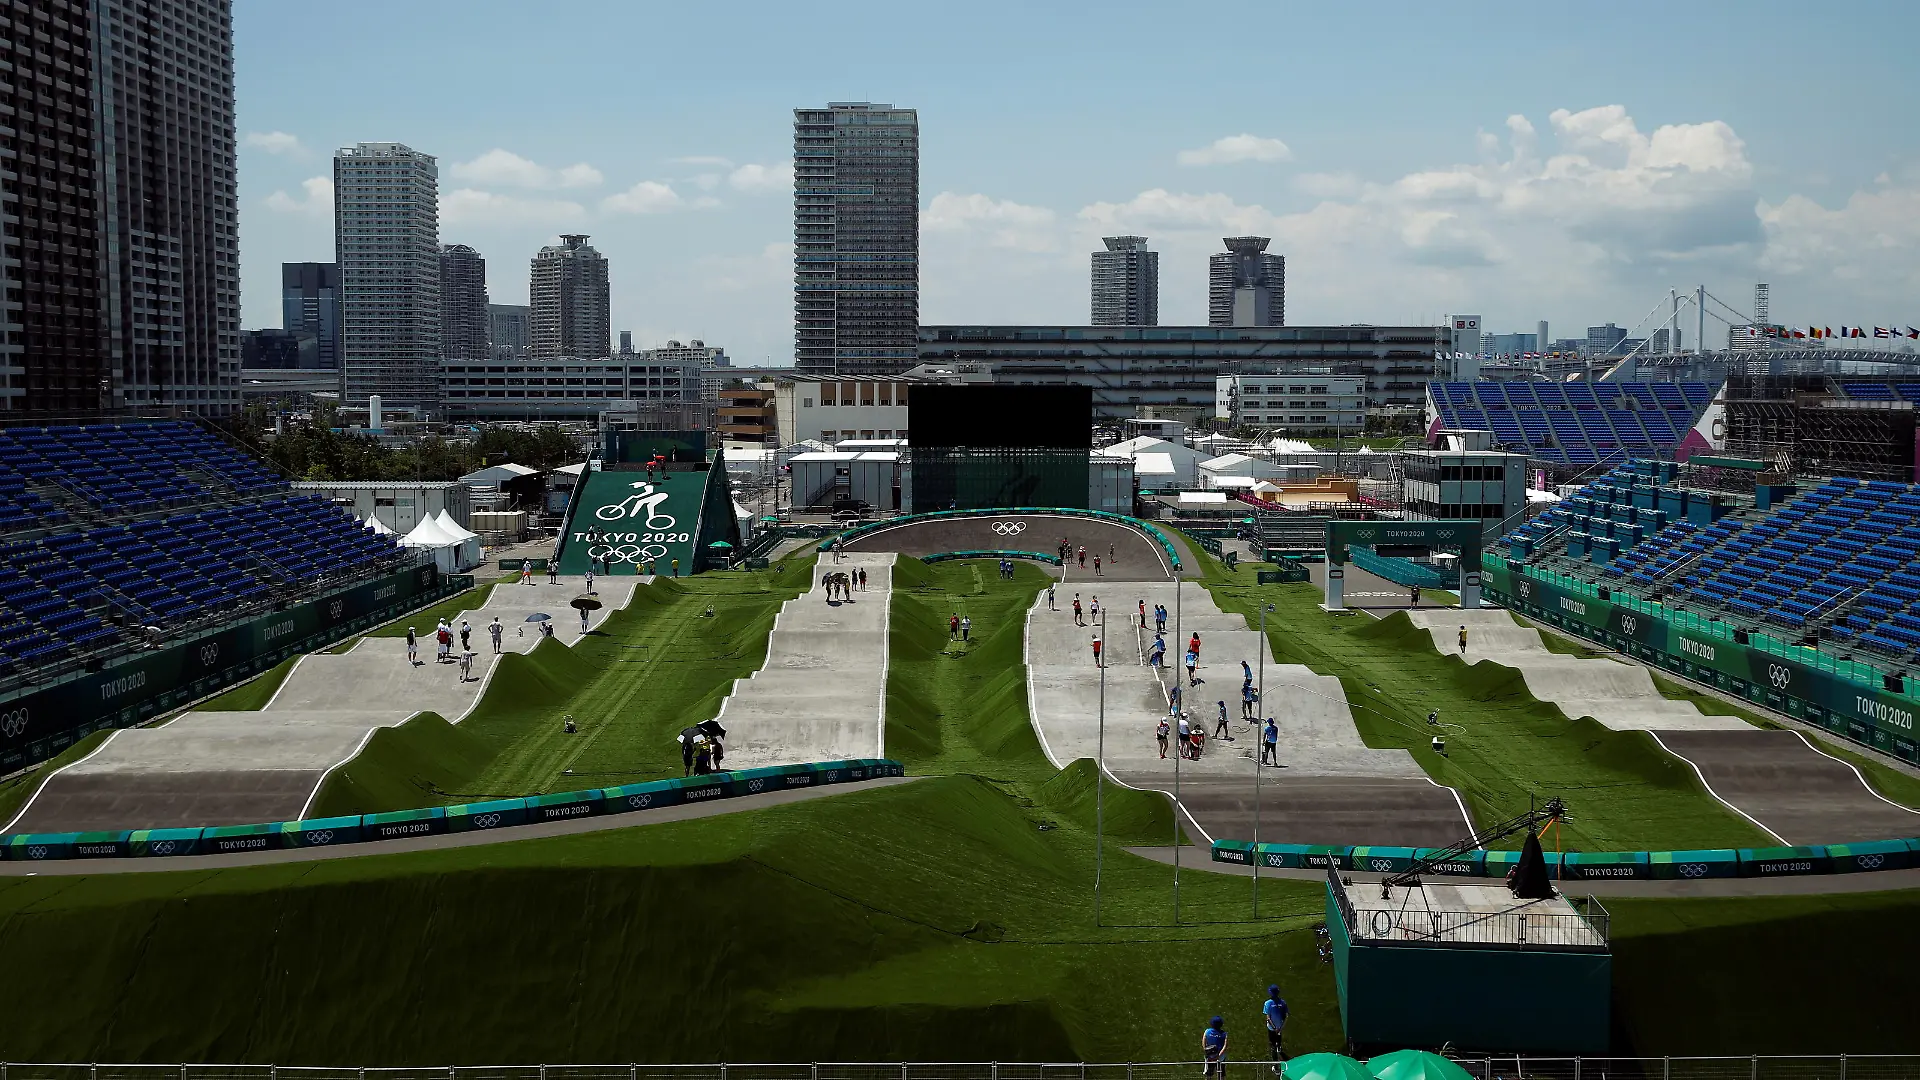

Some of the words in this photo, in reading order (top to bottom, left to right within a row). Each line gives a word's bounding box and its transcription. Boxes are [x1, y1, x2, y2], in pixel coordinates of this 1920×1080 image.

[573, 532, 638, 542] TOKYO
[641, 532, 690, 542] 2020
[1560, 596, 1574, 612] TOKYO
[1574, 601, 1586, 616] 2020
[263, 623, 281, 641] TOKYO
[281, 619, 294, 635] 2020
[1678, 636, 1699, 656] TOKYO
[1699, 643, 1715, 661] 2020
[100, 677, 127, 701] TOKYO
[127, 670, 146, 691] 2020
[1856, 695, 1887, 721] TOKYO
[1888, 706, 1912, 730] 2020
[686, 789, 706, 799] TOKYO
[706, 787, 721, 797] 2020
[545, 807, 570, 817] TOKYO
[571, 805, 590, 815] 2020
[381, 825, 408, 835] TOKYO
[409, 823, 429, 833] 2020
[79, 846, 100, 854] TOKYO
[100, 845, 116, 854] 2020
[219, 840, 246, 849] TOKYO
[246, 838, 266, 848] 2020
[1309, 857, 1327, 865] TOKYO
[1452, 864, 1471, 872] 2020
[1583, 868, 1612, 876] TOKYO
[1612, 867, 1634, 876] 2020
[1760, 863, 1788, 873] TOKYO
[1789, 862, 1811, 871] 2020
